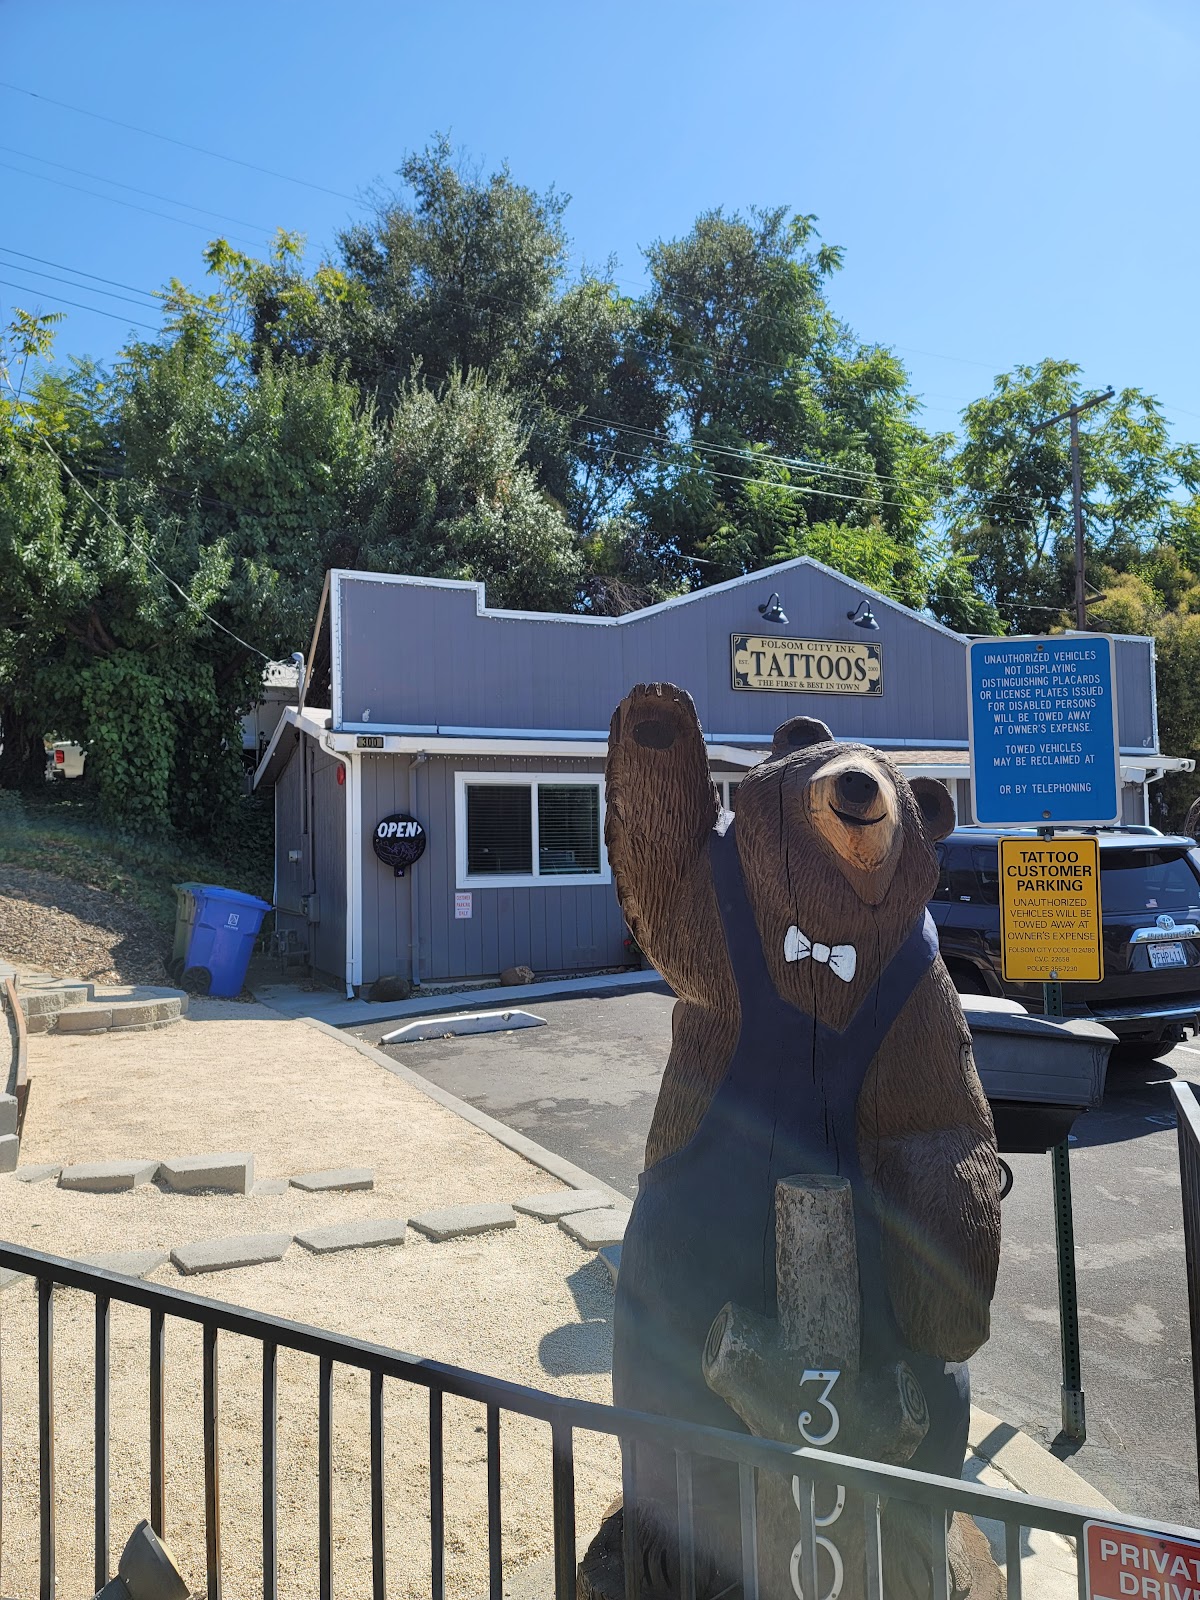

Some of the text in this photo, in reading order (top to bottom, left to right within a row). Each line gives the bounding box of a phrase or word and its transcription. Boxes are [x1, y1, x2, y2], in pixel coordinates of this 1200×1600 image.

[760, 640, 856, 654] FOLSOM CITY INK
[984, 651, 1096, 664] UNAUTHORIZED VEHICLES
[750, 651, 866, 682] TATTOOS
[1004, 664, 1076, 675] NOT DISPLAYING
[982, 674, 1100, 688] DISTINGUISHING PLACARDS
[980, 686, 1103, 700] OR LICENSE PLATES ISSUED
[988, 698, 1096, 711] FOR DISABLED PERSONS
[994, 710, 1091, 723] WILL BE TOWED AWAY
[994, 723, 1093, 735] AT OWNER'S EXPENSE.
[1005, 743, 1082, 754] TOWED VEHICLES
[993, 754, 1095, 766] MAY BE RECLAIMED AT
[1000, 783, 1092, 794] OR BY TELEPHONING
[378, 822, 418, 838] OPEN
[1020, 852, 1078, 863] TATTOO
[1007, 866, 1092, 877] CUSTOMER
[1017, 880, 1083, 891] PARKING
[1013, 899, 1087, 907] UNAUTHORIZED
[1010, 910, 1053, 918] VEHICLES
[1056, 910, 1078, 918] WILL
[1008, 932, 1095, 940] OWNER'S EXPENSE
